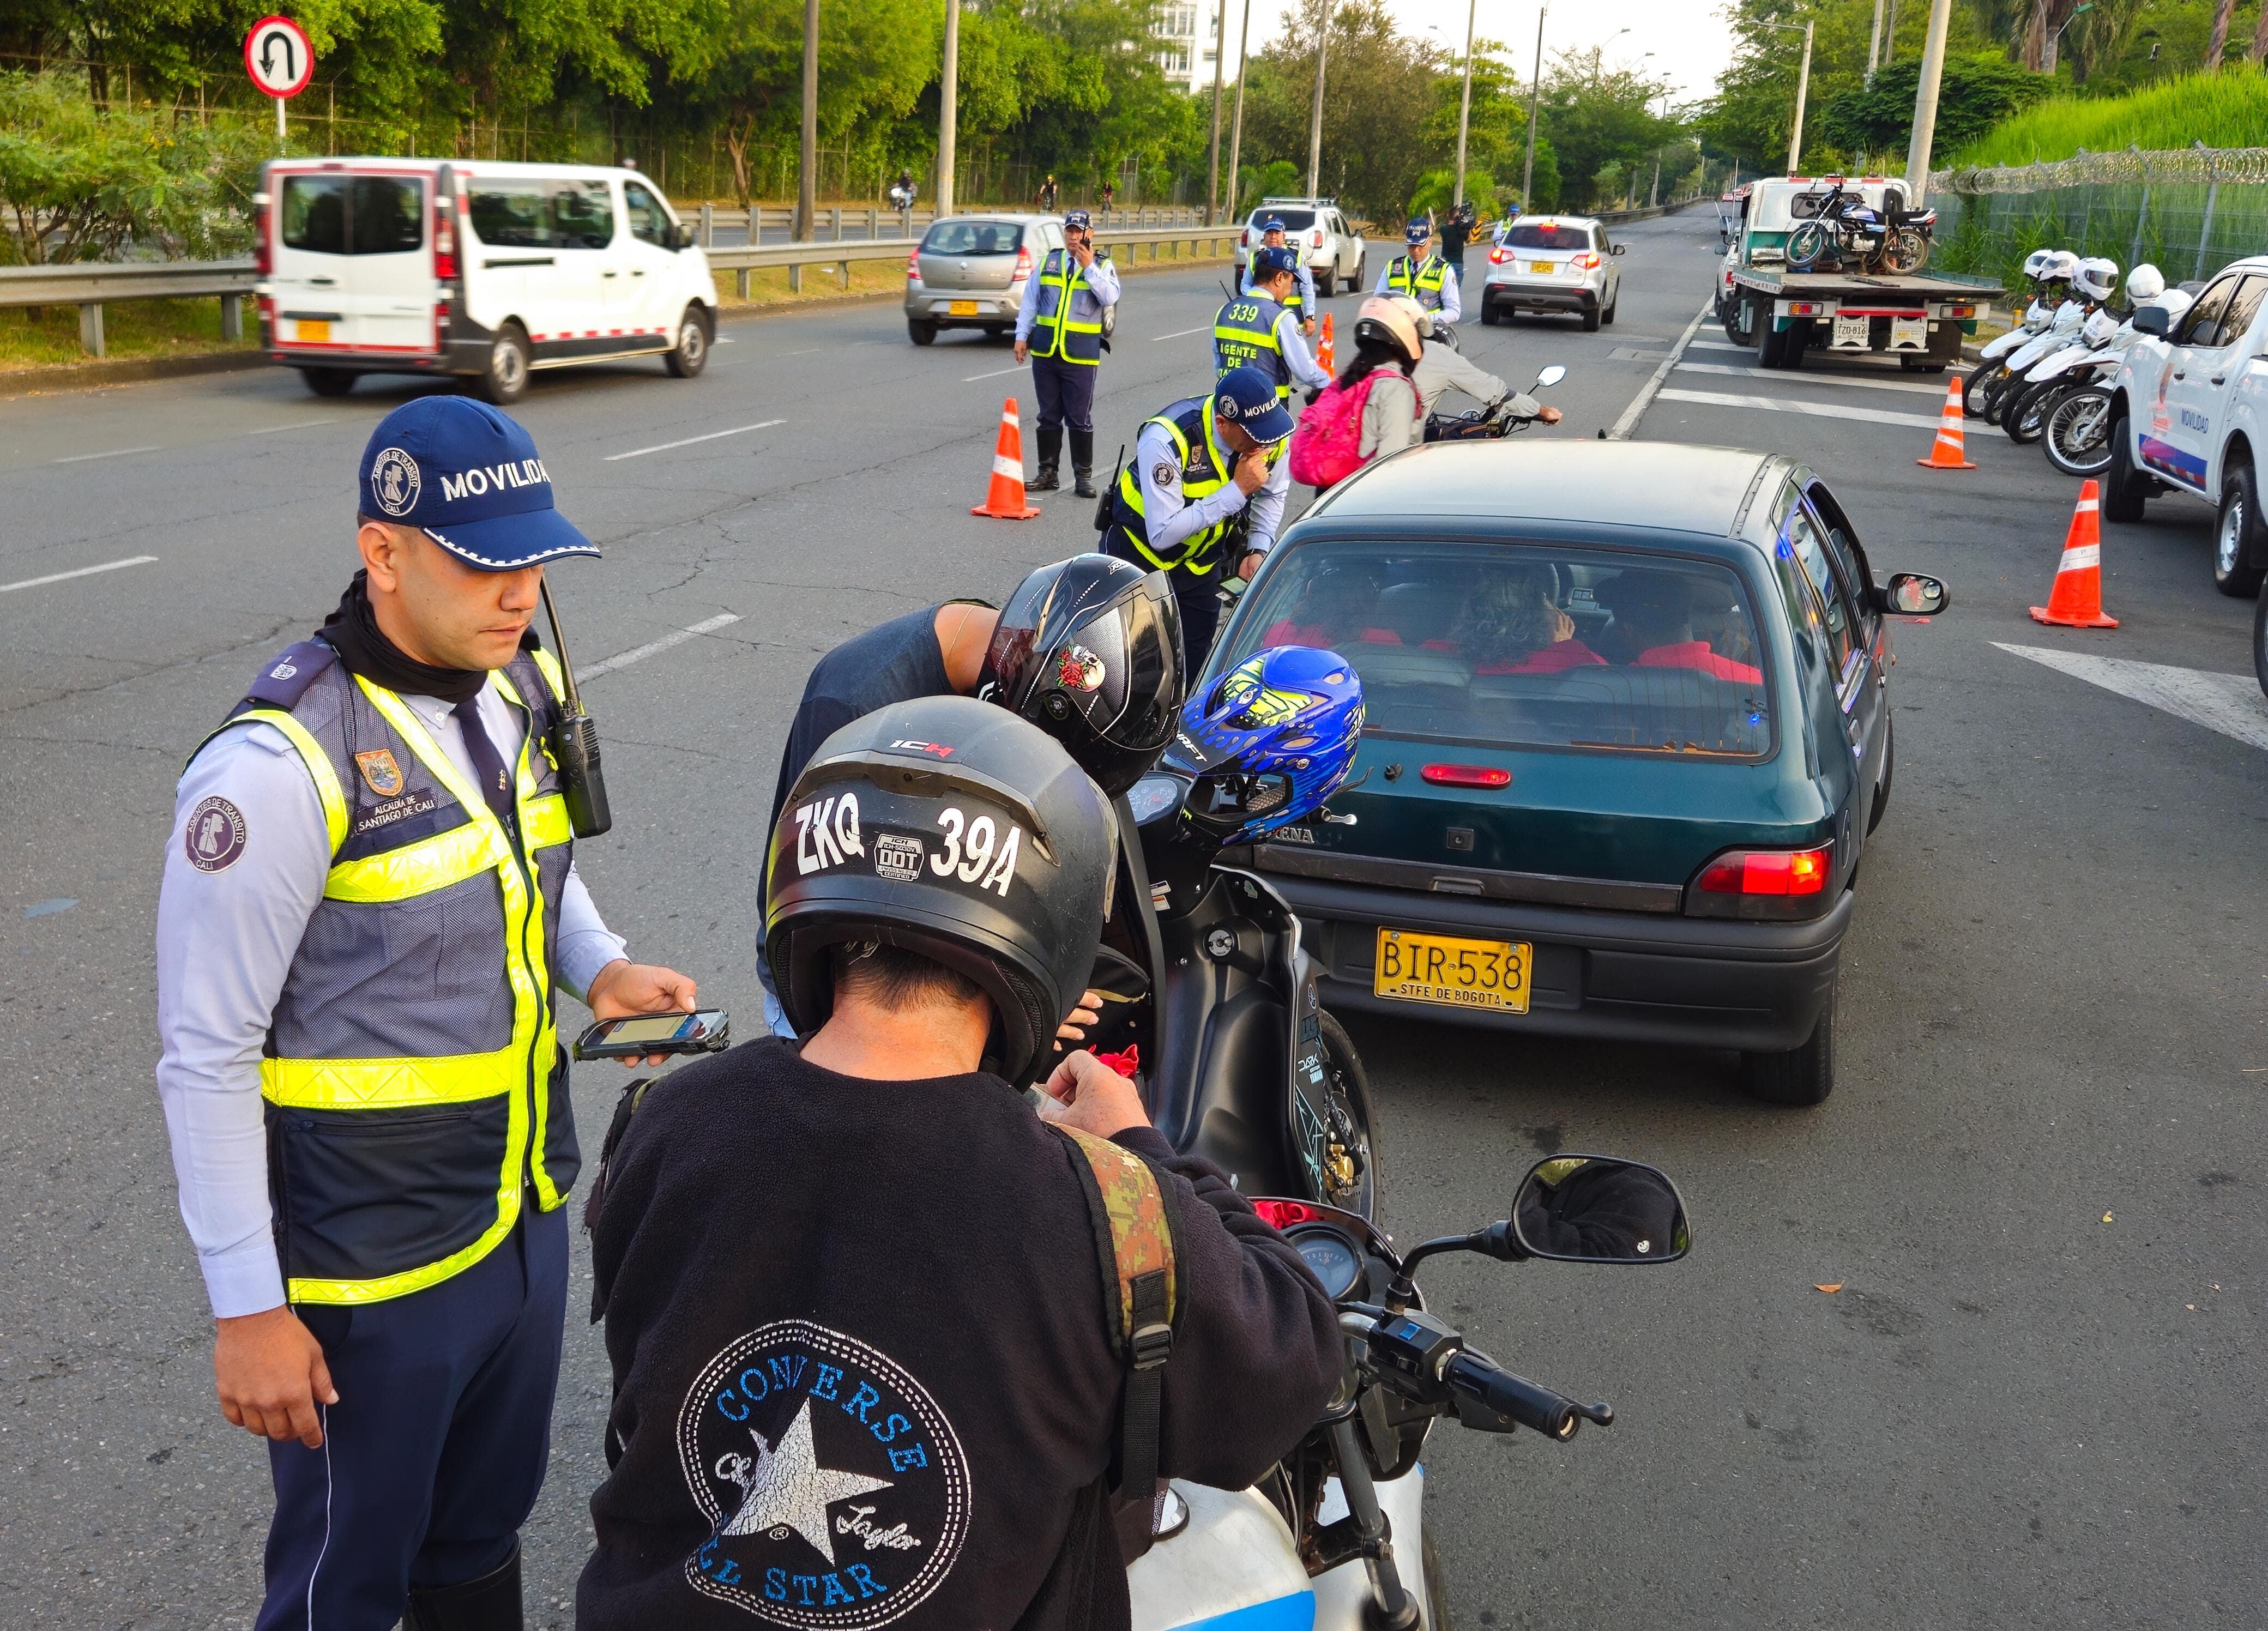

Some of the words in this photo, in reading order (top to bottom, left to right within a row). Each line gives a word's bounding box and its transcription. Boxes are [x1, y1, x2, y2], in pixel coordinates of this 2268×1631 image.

[1228, 304, 1259, 323] 339
[1227, 357, 1241, 369] DE
[2181, 408, 2209, 434] MOVILIDAD
[373, 451, 390, 480] AGENTES
[391, 451, 401, 460] DE
[400, 455, 418, 488] TRANSITO
[386, 503, 401, 514] CALI
[406, 795, 417, 805] DE
[188, 798, 212, 833] AGENTES
[212, 798, 222, 807] DE
[222, 801, 245, 843] TRANSITO
[359, 810, 401, 831] SANTIAGO
[403, 807, 414, 817] DE
[415, 799, 435, 813] CALI
[795, 792, 865, 876] ZKQ
[879, 849, 918, 869] DOT
[930, 807, 1022, 898] 39A
[196, 859, 213, 871] CALI
[1437, 987, 1451, 1000] DE
[1455, 989, 1502, 1006] BOGOTA
[765, 1562, 888, 1606] STAR
